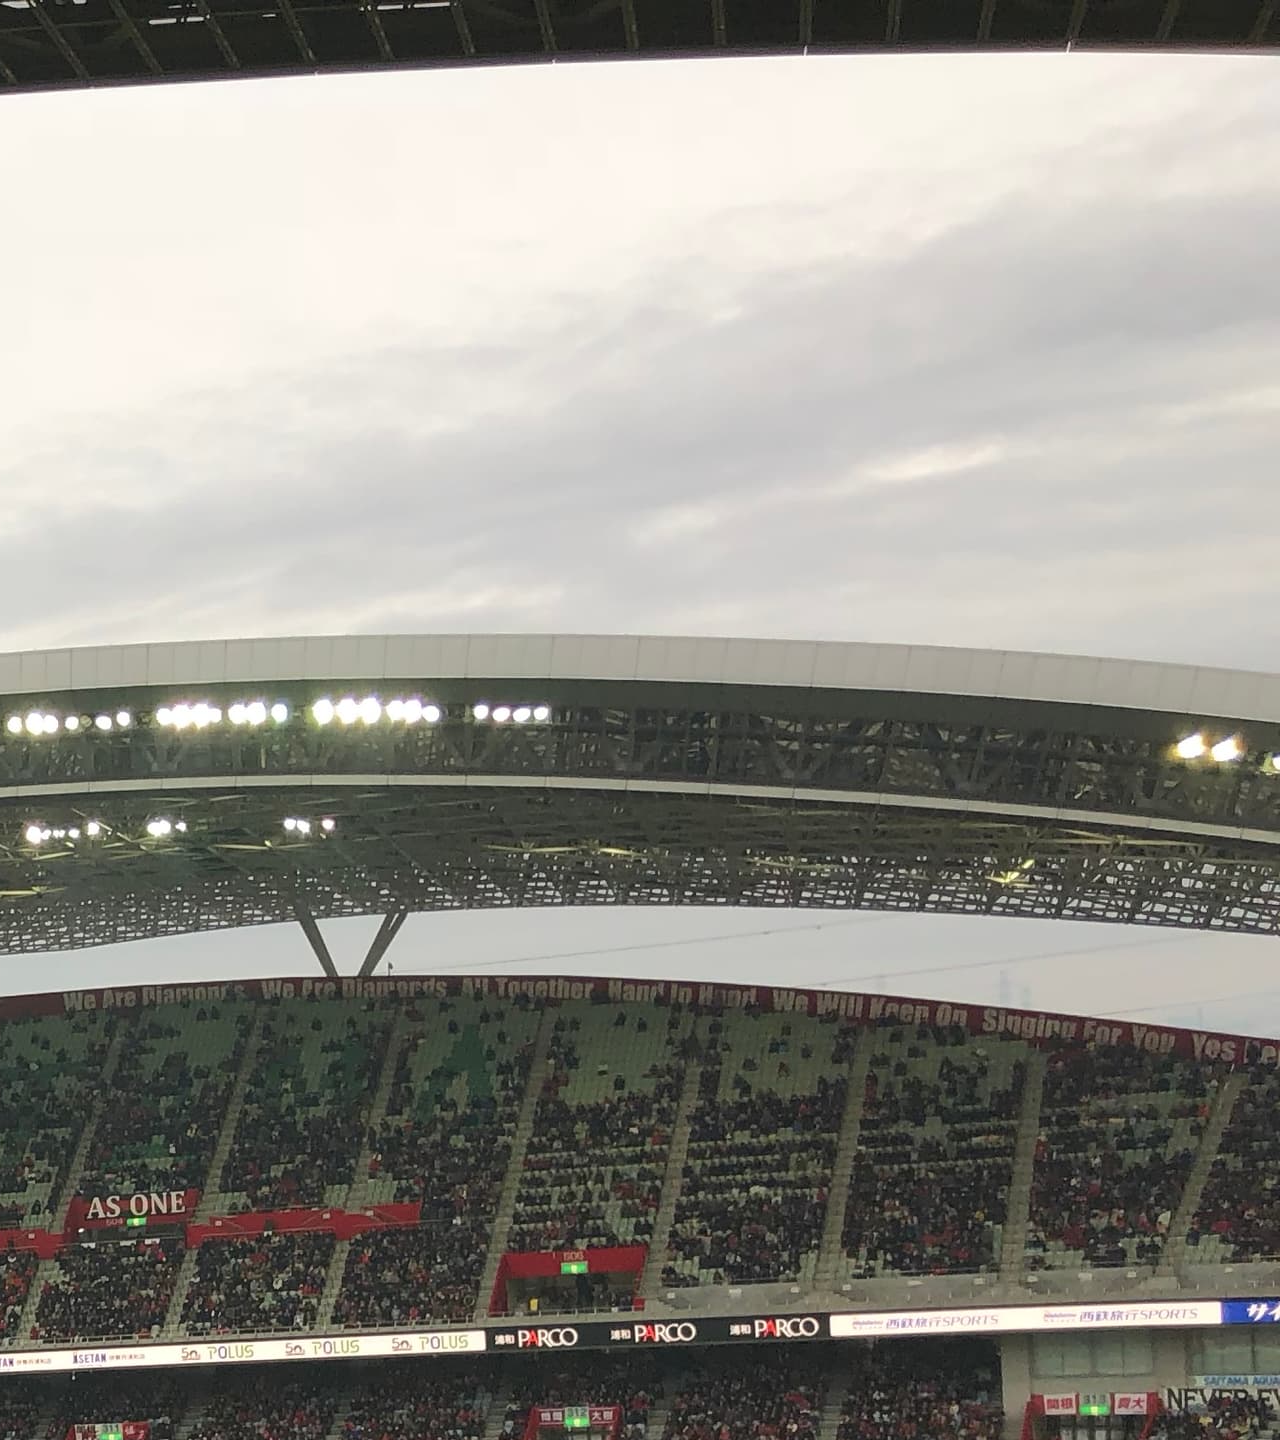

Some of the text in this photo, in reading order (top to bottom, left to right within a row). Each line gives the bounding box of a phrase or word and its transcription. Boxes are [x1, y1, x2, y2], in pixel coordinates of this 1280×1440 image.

[64, 989, 97, 1011] We
[103, 988, 137, 1008] Are
[261, 979, 296, 999] We
[497, 977, 594, 1000] Together
[608, 980, 665, 1002] Hand
[670, 983, 693, 1004] In
[773, 988, 809, 1012] We
[816, 990, 863, 1017] Will
[935, 1004, 967, 1027] On
[982, 1008, 1175, 1053] Singing For You
[1191, 1035, 1236, 1062] Yes
[86, 1191, 186, 1219] AS ONE
[518, 1327, 578, 1348] PARCO
[634, 1322, 697, 1344] PARCO
[754, 1317, 820, 1339] PARCO
[207, 1345, 254, 1360] POLUS
[312, 1340, 360, 1354] POLUS
[419, 1335, 469, 1350] POLUS
